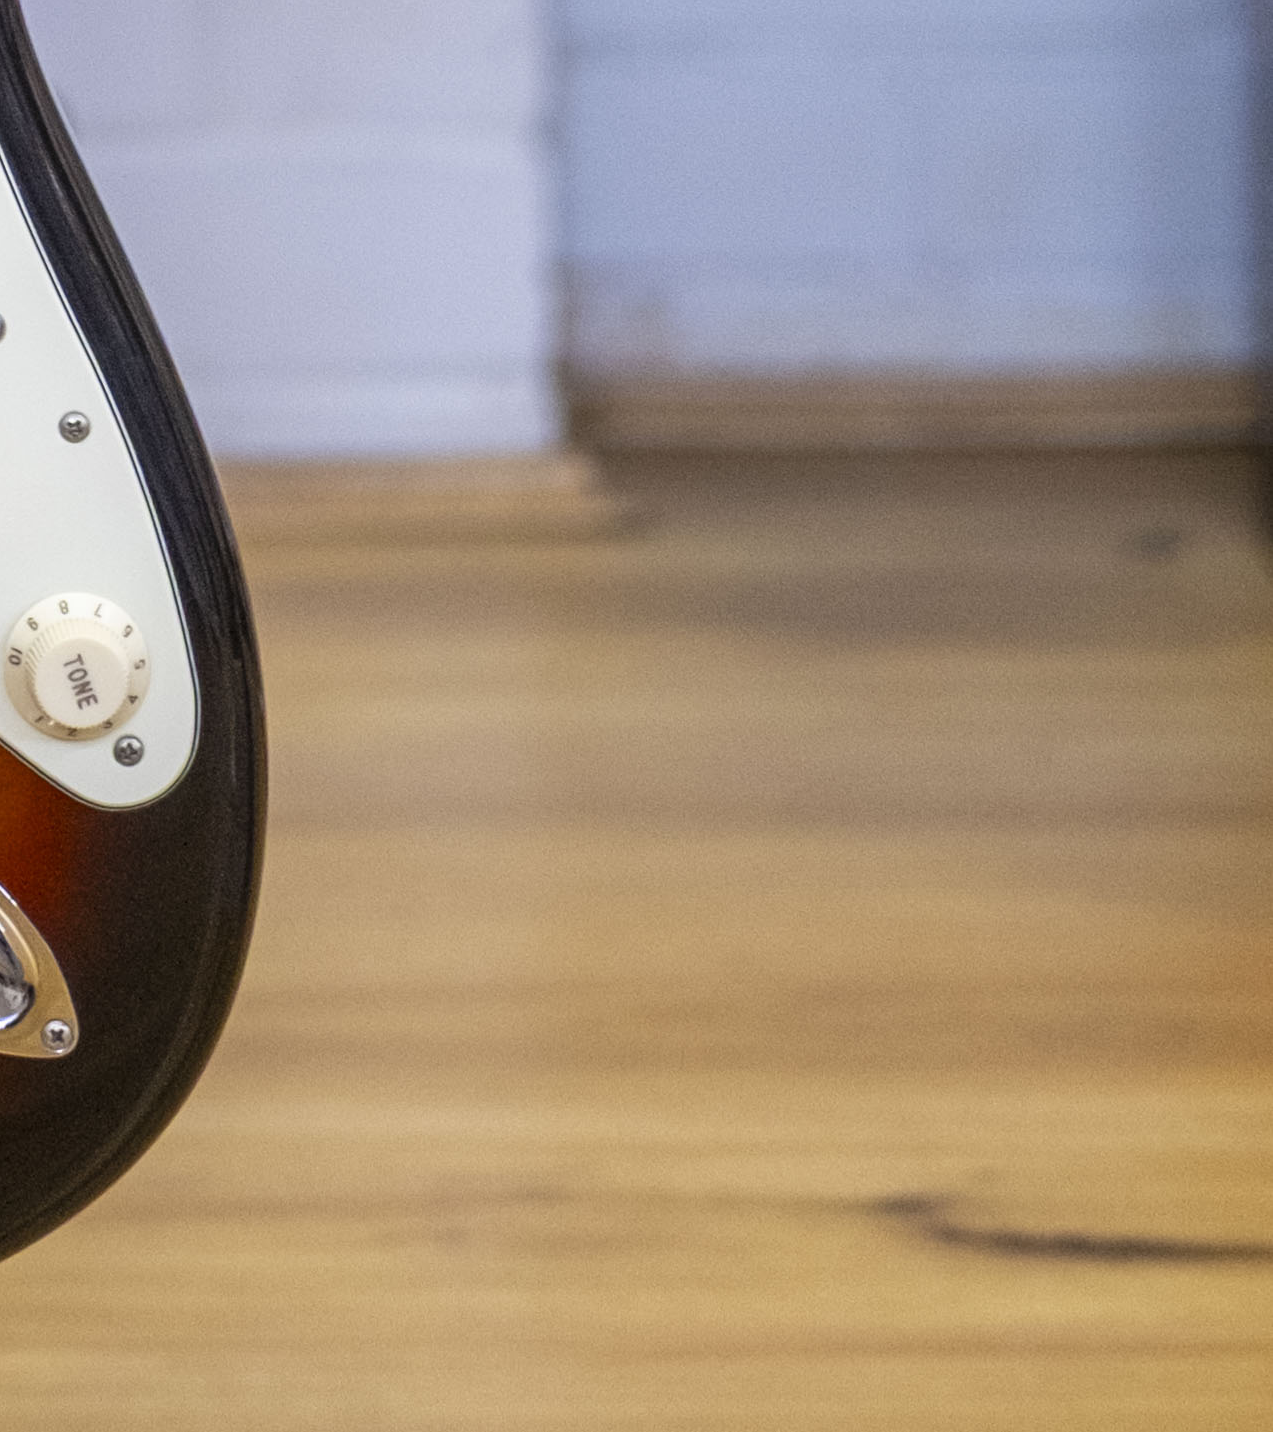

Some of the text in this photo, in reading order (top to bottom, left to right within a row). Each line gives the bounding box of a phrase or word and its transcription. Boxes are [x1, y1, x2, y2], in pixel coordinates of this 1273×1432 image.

[58, 599, 69, 615] 8
[94, 603, 102, 618] 7
[26, 617, 39, 631] 9
[123, 625, 133, 638] 6
[7, 647, 23, 666] 10
[62, 653, 98, 710] TONE
[128, 694, 139, 704] 4
[67, 727, 78, 737] 2
